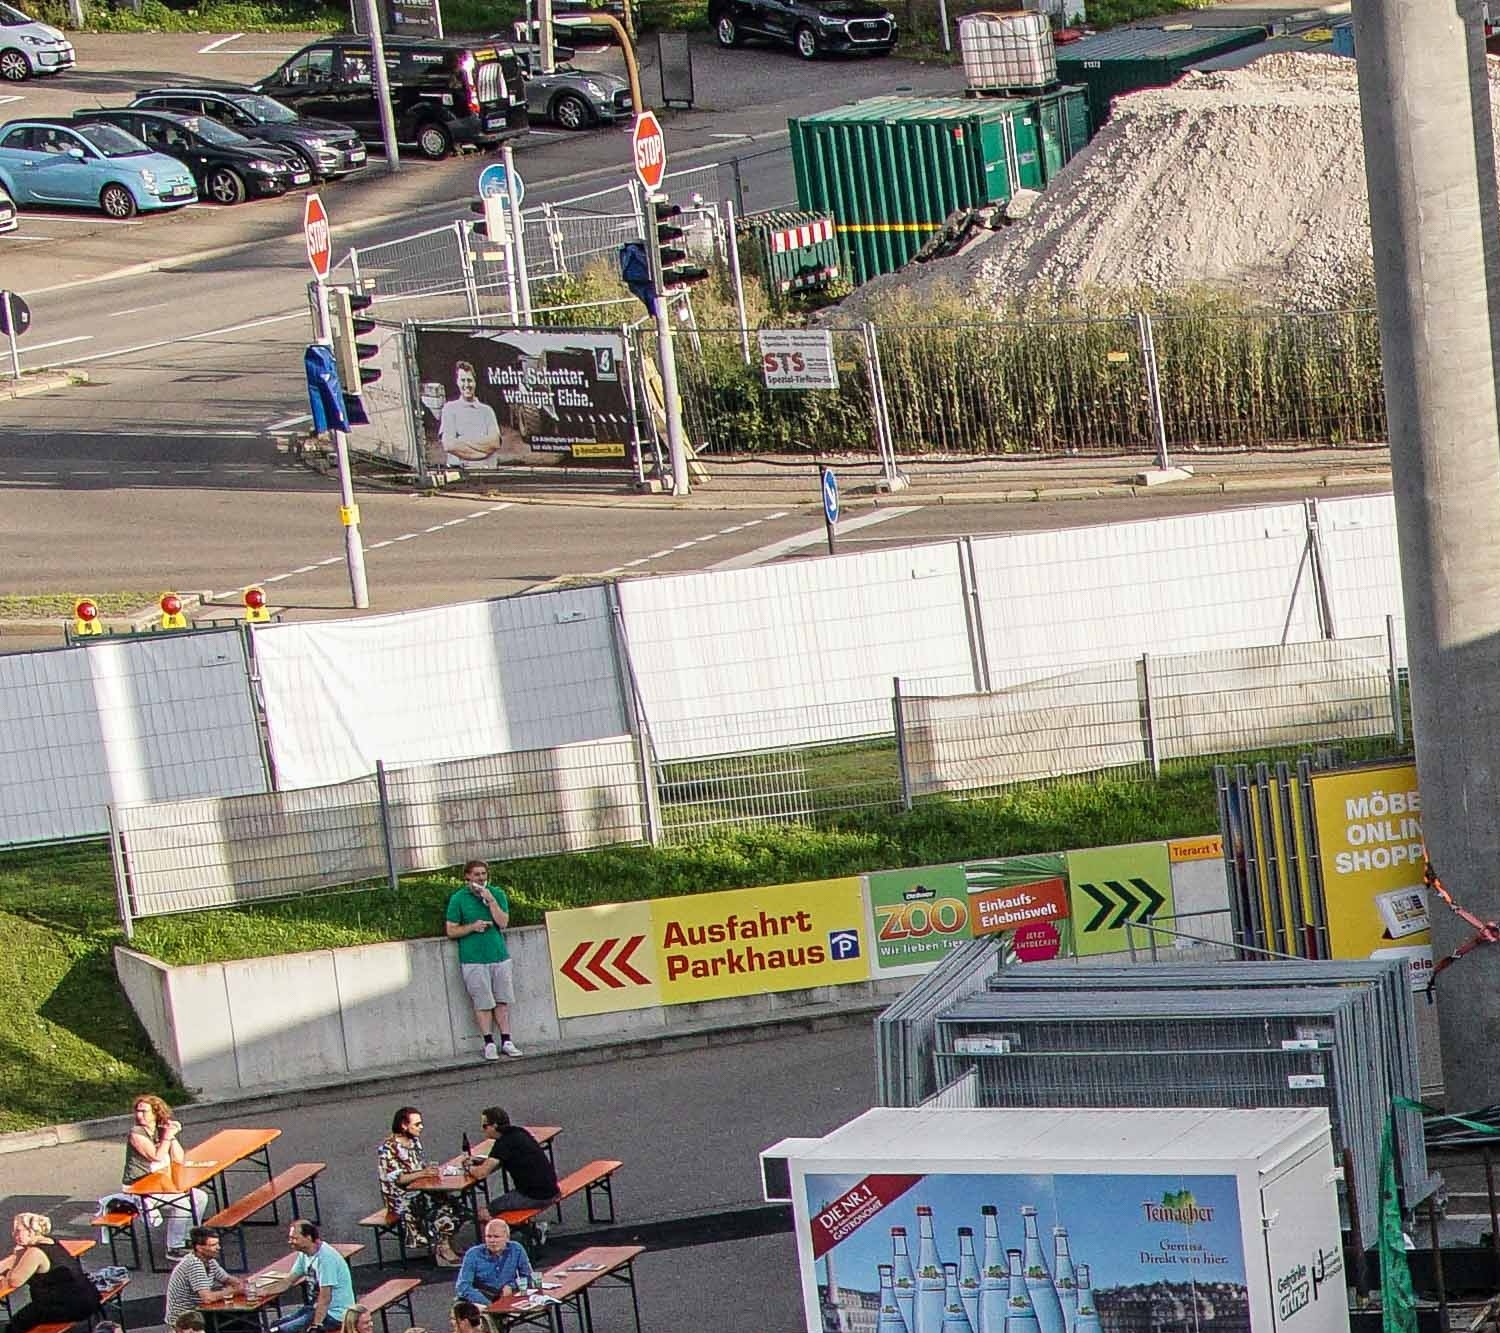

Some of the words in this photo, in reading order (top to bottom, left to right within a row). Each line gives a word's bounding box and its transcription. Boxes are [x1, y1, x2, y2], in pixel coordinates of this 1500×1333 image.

[637, 138, 662, 169] STOP
[307, 220, 328, 253] STOP
[764, 352, 805, 375] STS
[488, 366, 522, 385] Mehr
[527, 368, 589, 388] Schotter,
[504, 389, 555, 409] weniger
[558, 389, 593, 408] Ebbe.
[978, 892, 1038, 914] Einkaufs-
[875, 898, 969, 942] ZOO
[981, 904, 1058, 928] Erlebniswelt
[663, 911, 813, 949] Ausfahrt
[880, 944, 899, 957] Wir
[903, 941, 938, 954] lieben
[666, 943, 826, 982] Parkhaus
[820, 1205, 845, 1230] DIE
[832, 1198, 884, 1242] GASTRONOMIE
[1142, 1201, 1215, 1224] Teinacher
[1140, 1251, 1177, 1265] Direkt
[1180, 1253, 1201, 1265] von
[1203, 1252, 1230, 1265] hier.
